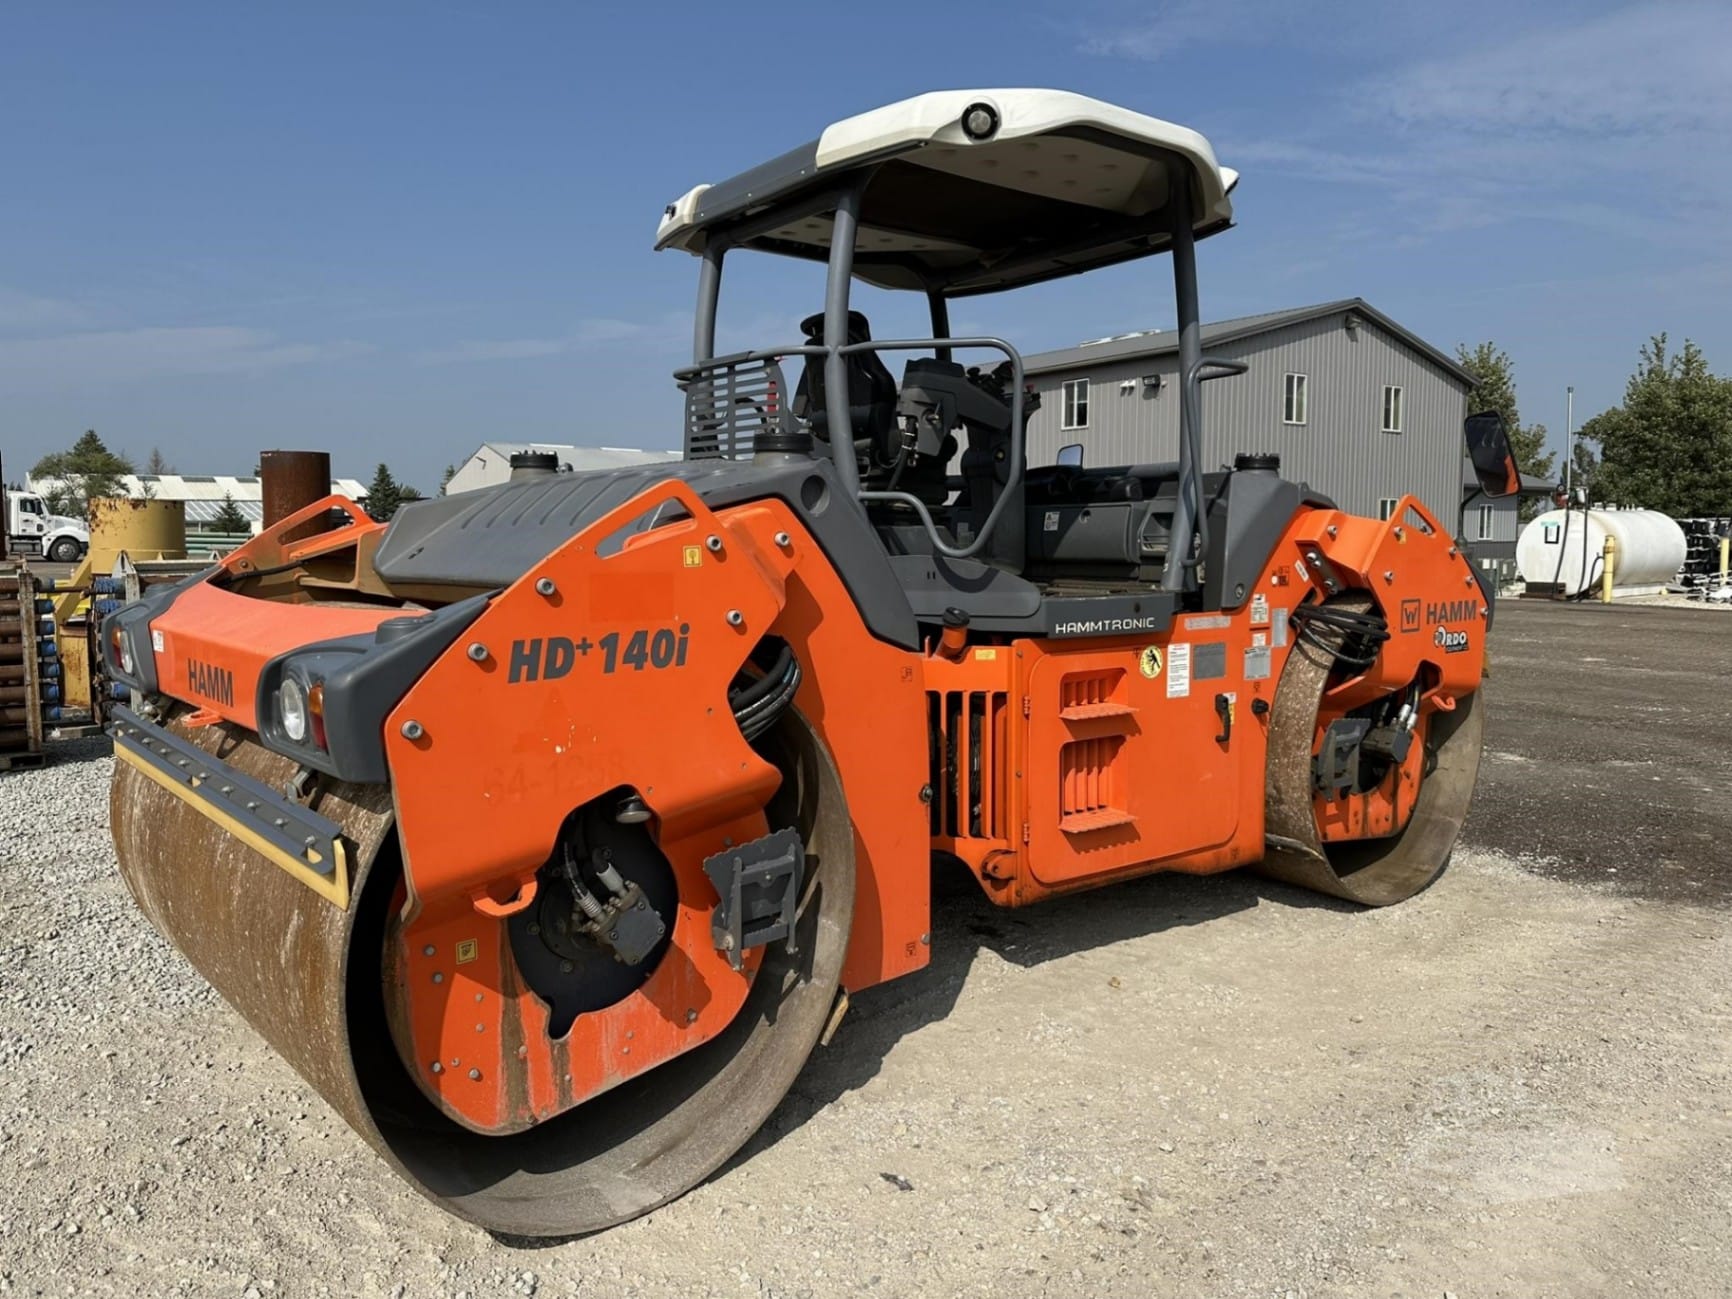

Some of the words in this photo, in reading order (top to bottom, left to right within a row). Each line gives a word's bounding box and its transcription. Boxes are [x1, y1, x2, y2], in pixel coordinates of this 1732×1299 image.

[1055, 617, 1155, 634] HAMMTRONIC
[1426, 600, 1477, 625] HAMM
[599, 623, 690, 674] 140i
[187, 657, 234, 708] HAMM
